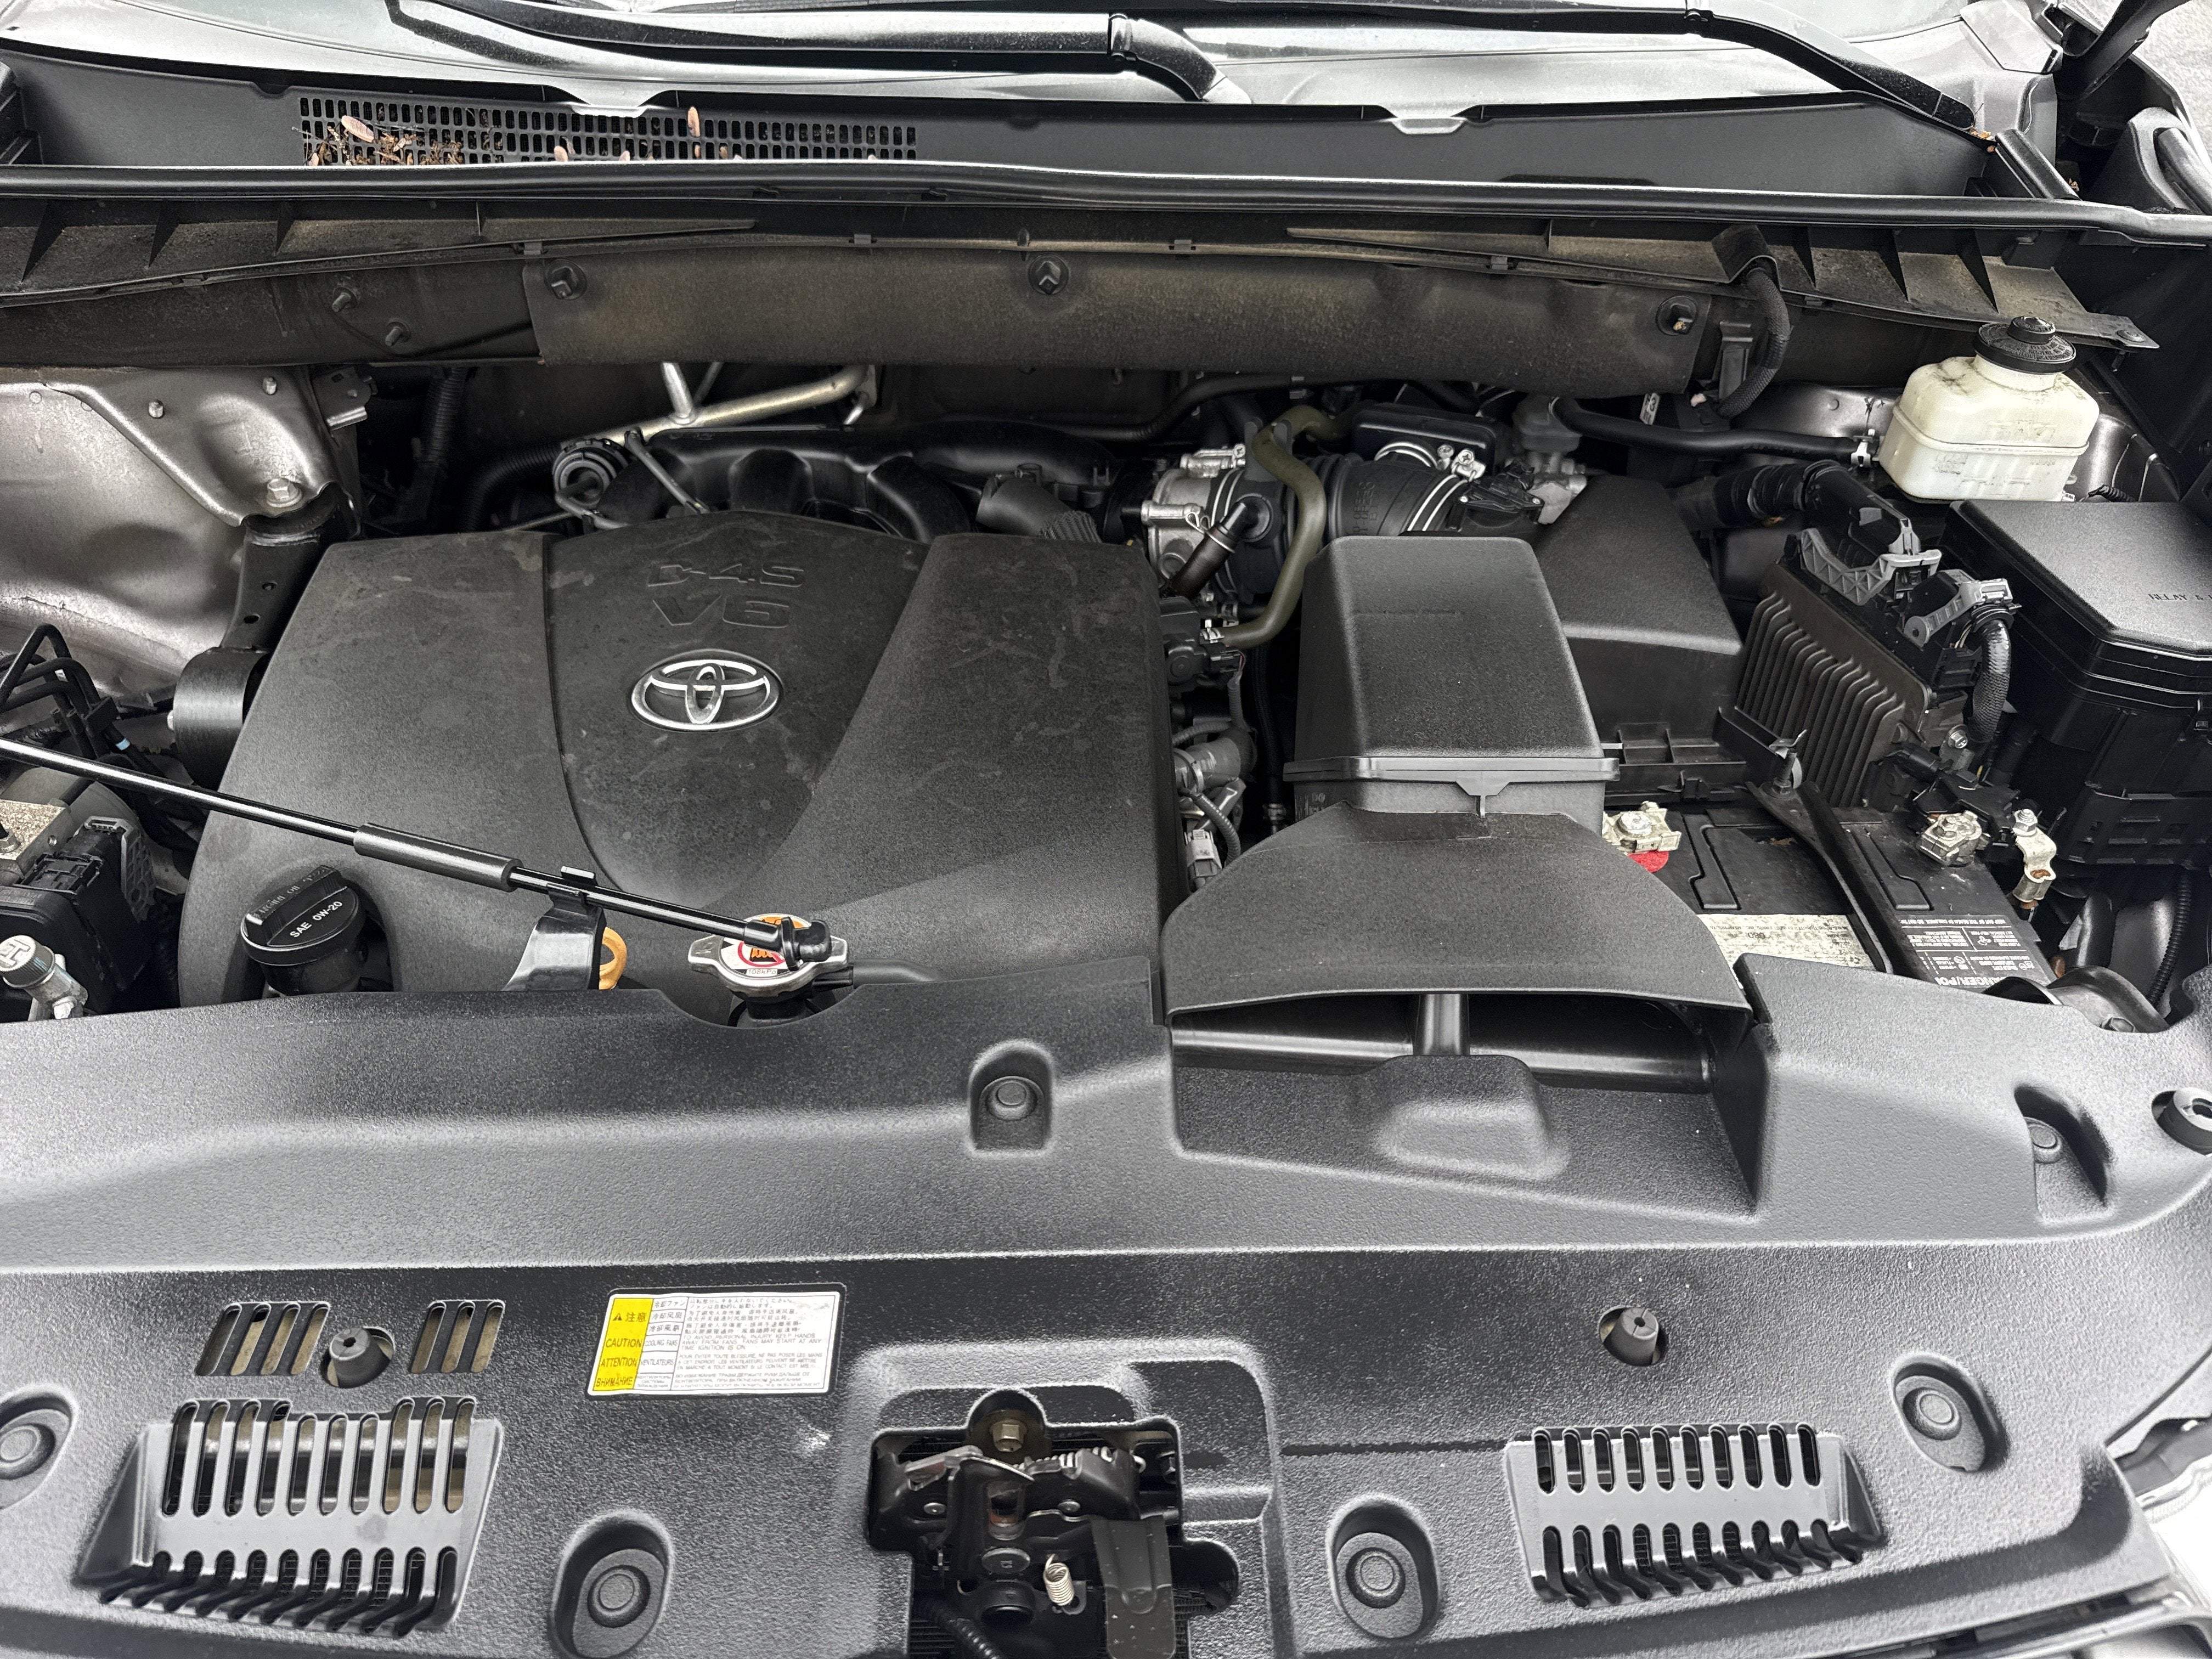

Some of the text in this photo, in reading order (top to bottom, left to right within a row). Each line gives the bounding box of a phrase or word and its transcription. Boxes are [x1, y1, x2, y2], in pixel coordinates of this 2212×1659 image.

[648, 563, 804, 587] D-4S
[652, 594, 791, 629] V6
[290, 901, 343, 938] SAE 0W-20
[1934, 976, 2006, 985] ANGER/POI
[625, 1312, 647, 1322] 注意
[606, 1338, 643, 1348] CAUTION
[601, 1357, 637, 1368] ATTENTION
[596, 1376, 633, 1387] ВНИМАНИЕ
